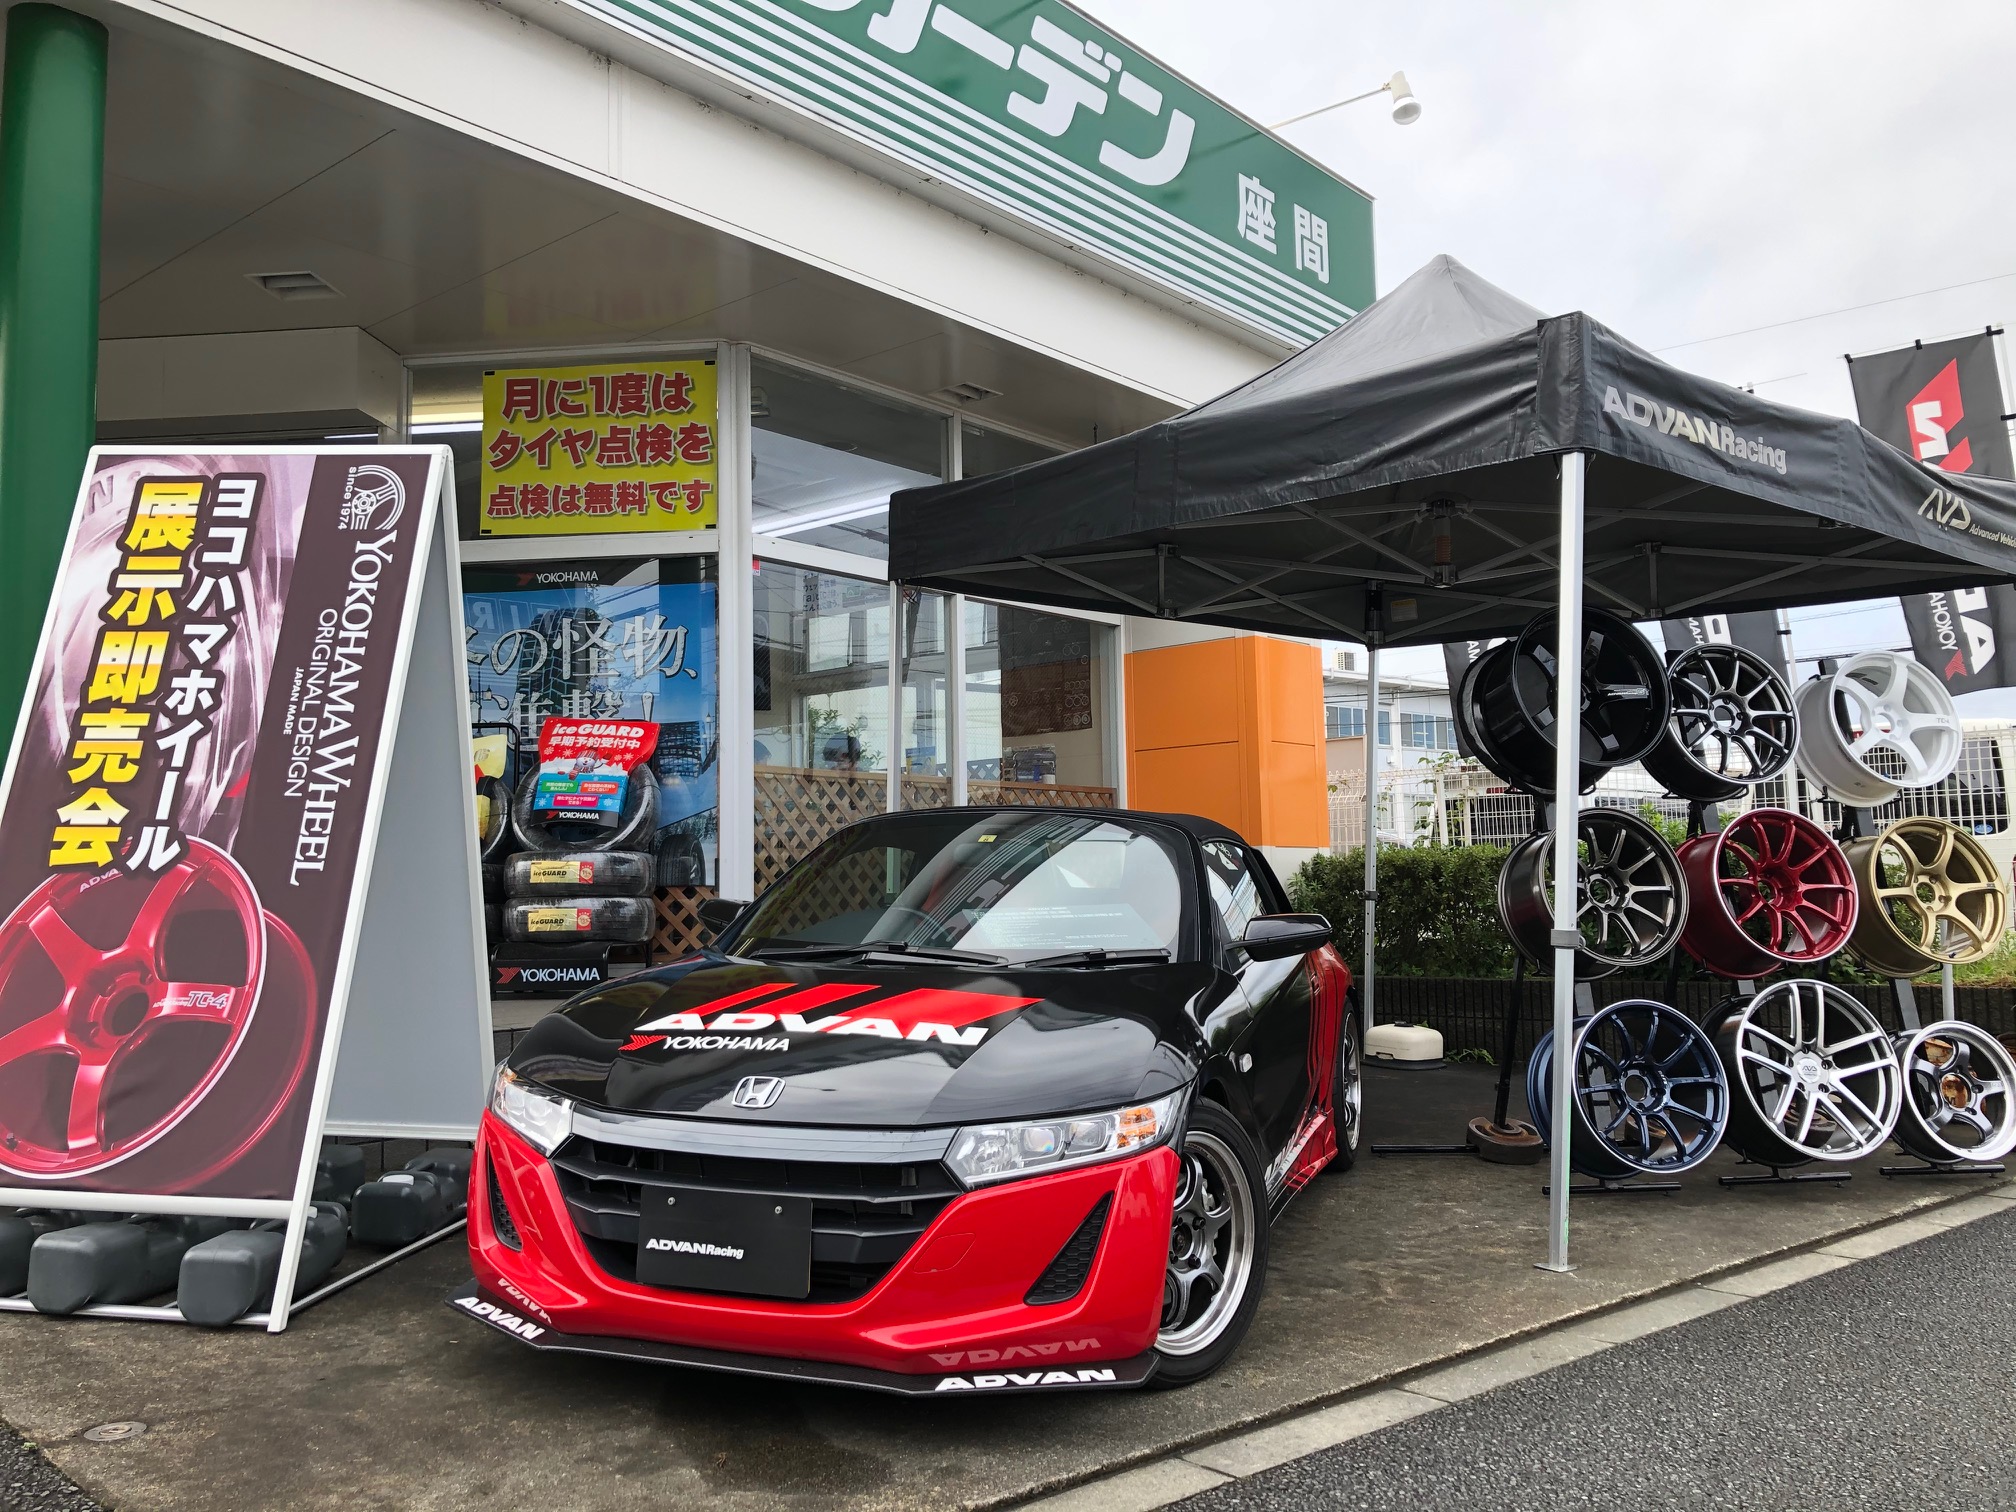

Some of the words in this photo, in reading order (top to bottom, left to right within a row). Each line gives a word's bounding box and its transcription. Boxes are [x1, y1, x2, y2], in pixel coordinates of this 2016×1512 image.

[1237, 172, 1331, 284] 座間
[501, 371, 693, 422] 月に1度は
[488, 421, 714, 470] タイヤ点検を
[343, 466, 358, 500] since
[486, 479, 712, 517] 点検は無料です
[337, 501, 352, 530] 1974
[1968, 523, 2001, 542] Advanced
[536, 570, 599, 584] YOKOHAMA
[48, 481, 204, 868] 展示即売会
[125, 479, 259, 872] ヨコハマホイール
[301, 608, 338, 712] ORIGINAL
[289, 666, 304, 702] JAPAN
[283, 704, 298, 735] MADE
[284, 716, 318, 797] DESIGN
[548, 735, 641, 750] 早期予約受付中
[558, 811, 600, 820] YOKOHAMA
[520, 967, 601, 982] YOKOHAMA
[188, 990, 231, 1010] TC-4
[634, 1013, 990, 1046] ADVAN
[661, 1035, 791, 1051] YOKOHAMA
[453, 1296, 546, 1340] ADVAN
[934, 1368, 1117, 1392] ADVAN
